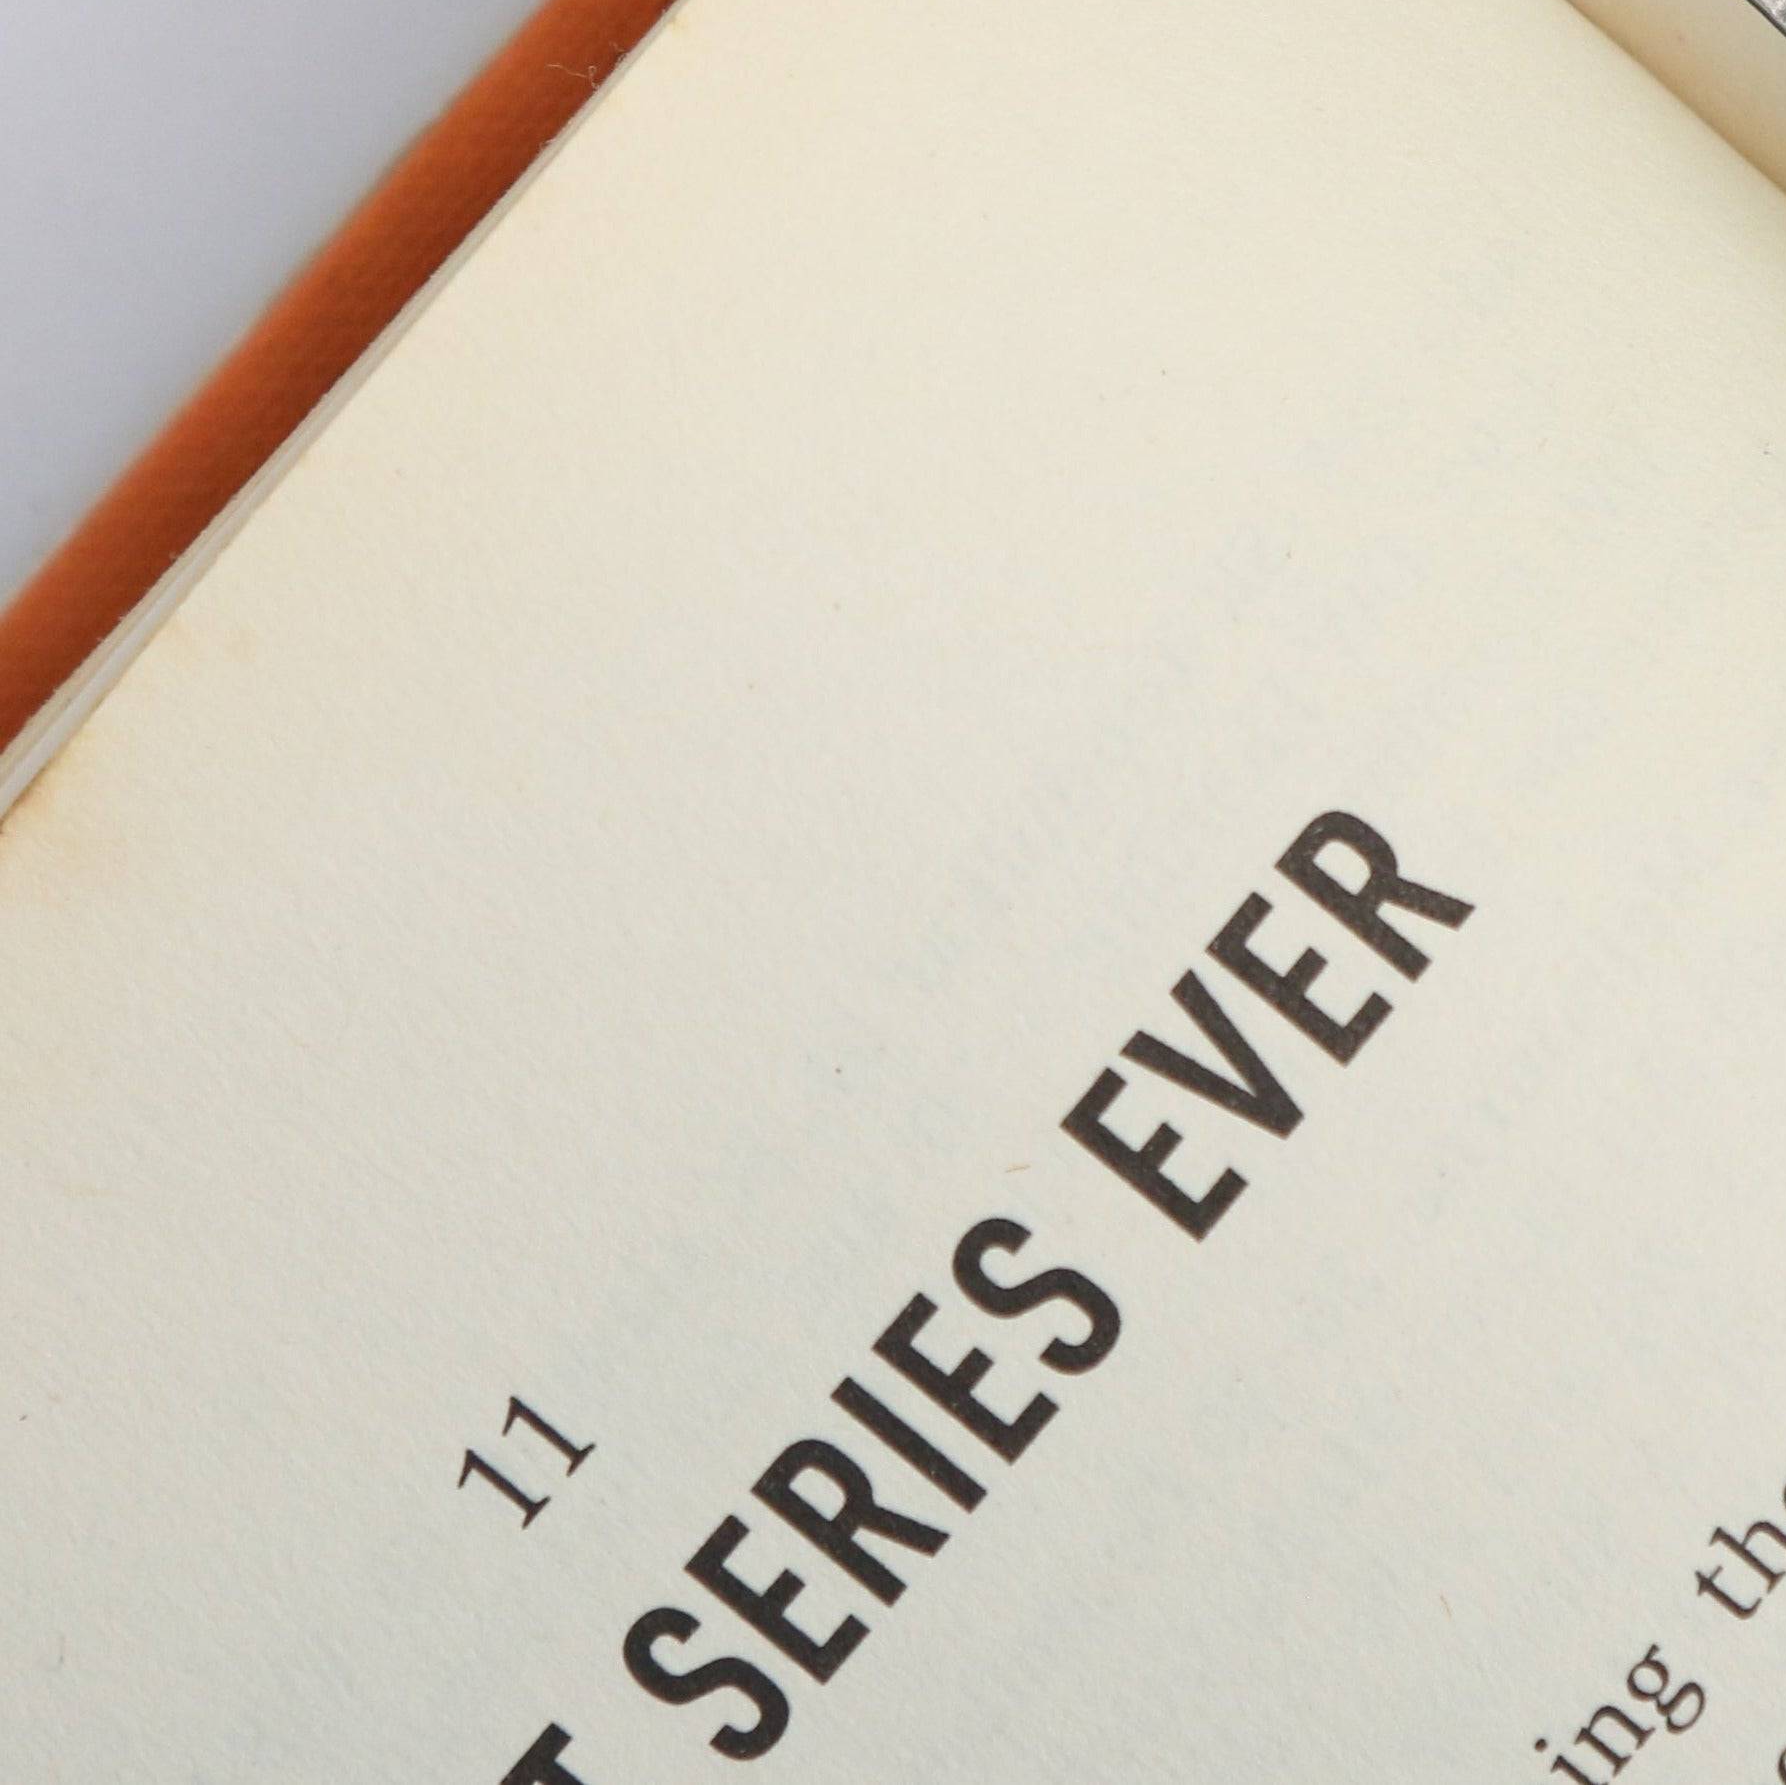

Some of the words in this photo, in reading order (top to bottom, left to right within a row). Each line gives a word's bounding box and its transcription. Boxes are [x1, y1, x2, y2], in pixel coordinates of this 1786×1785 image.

[457, 1395, 596, 1529] 11
[622, 1217, 1122, 1761] SERIES
[1059, 810, 1476, 1242] EVER
